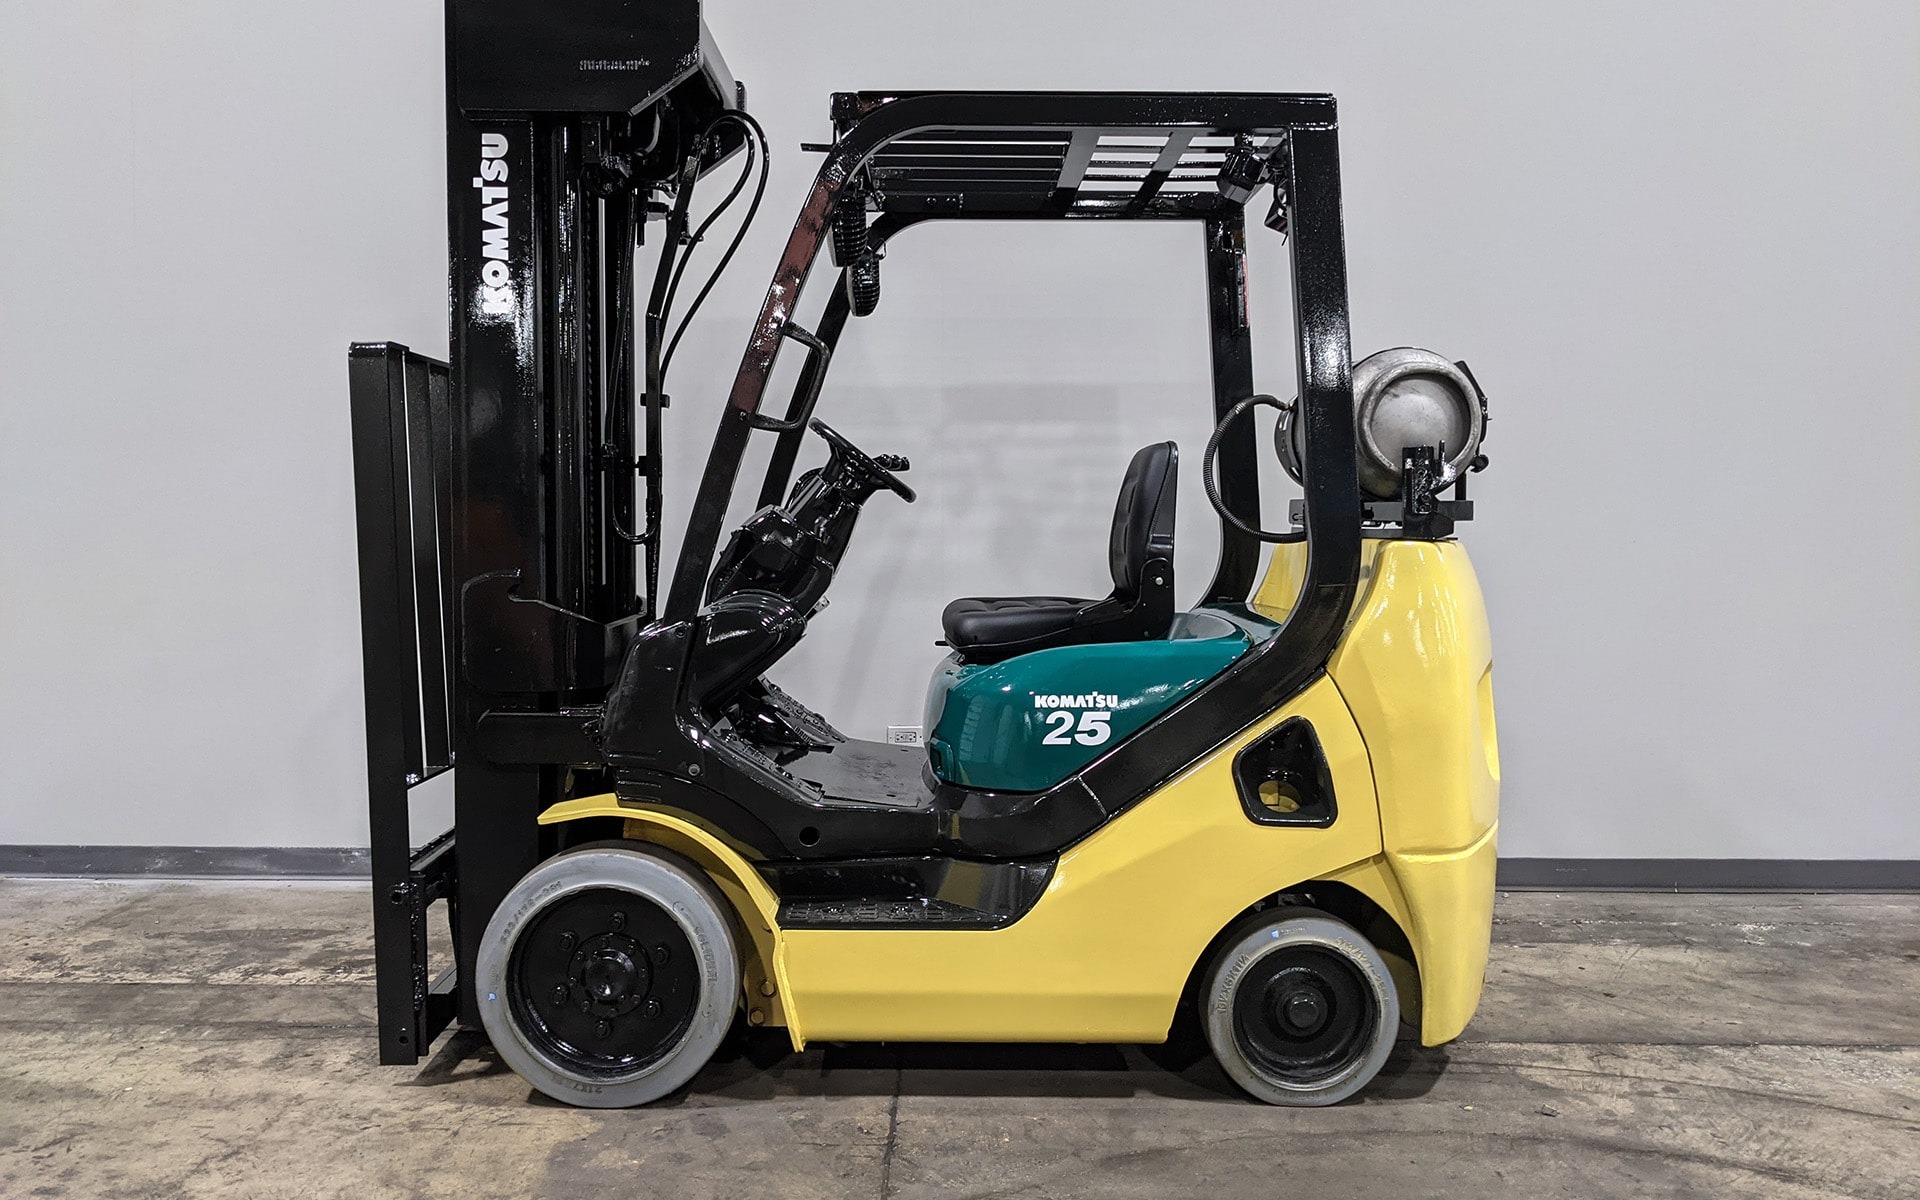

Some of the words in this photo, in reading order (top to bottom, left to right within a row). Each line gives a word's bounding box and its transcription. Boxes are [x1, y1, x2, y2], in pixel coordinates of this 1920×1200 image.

[473, 133, 509, 314] KOMATSU
[1034, 691, 1118, 708] KOMATSU
[1042, 710, 1111, 746] 25
